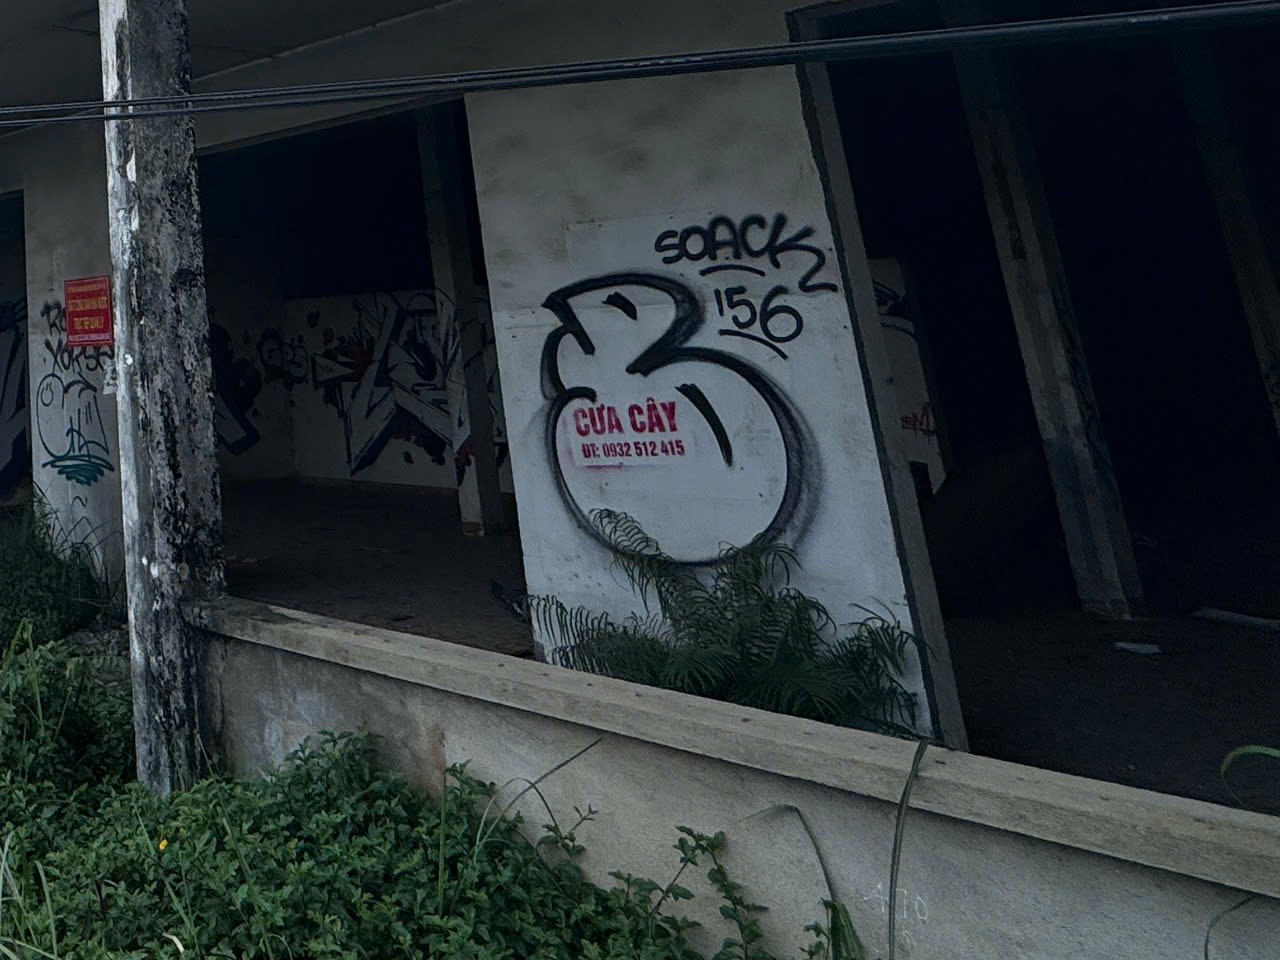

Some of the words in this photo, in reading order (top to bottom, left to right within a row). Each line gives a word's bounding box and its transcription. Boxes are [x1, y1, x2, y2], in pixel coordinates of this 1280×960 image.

[574, 403, 624, 437] CƯA
[628, 397, 678, 433] CÂY
[602, 442, 632, 458] 0932
[633, 441, 658, 456] 512
[661, 440, 685, 456] 415
